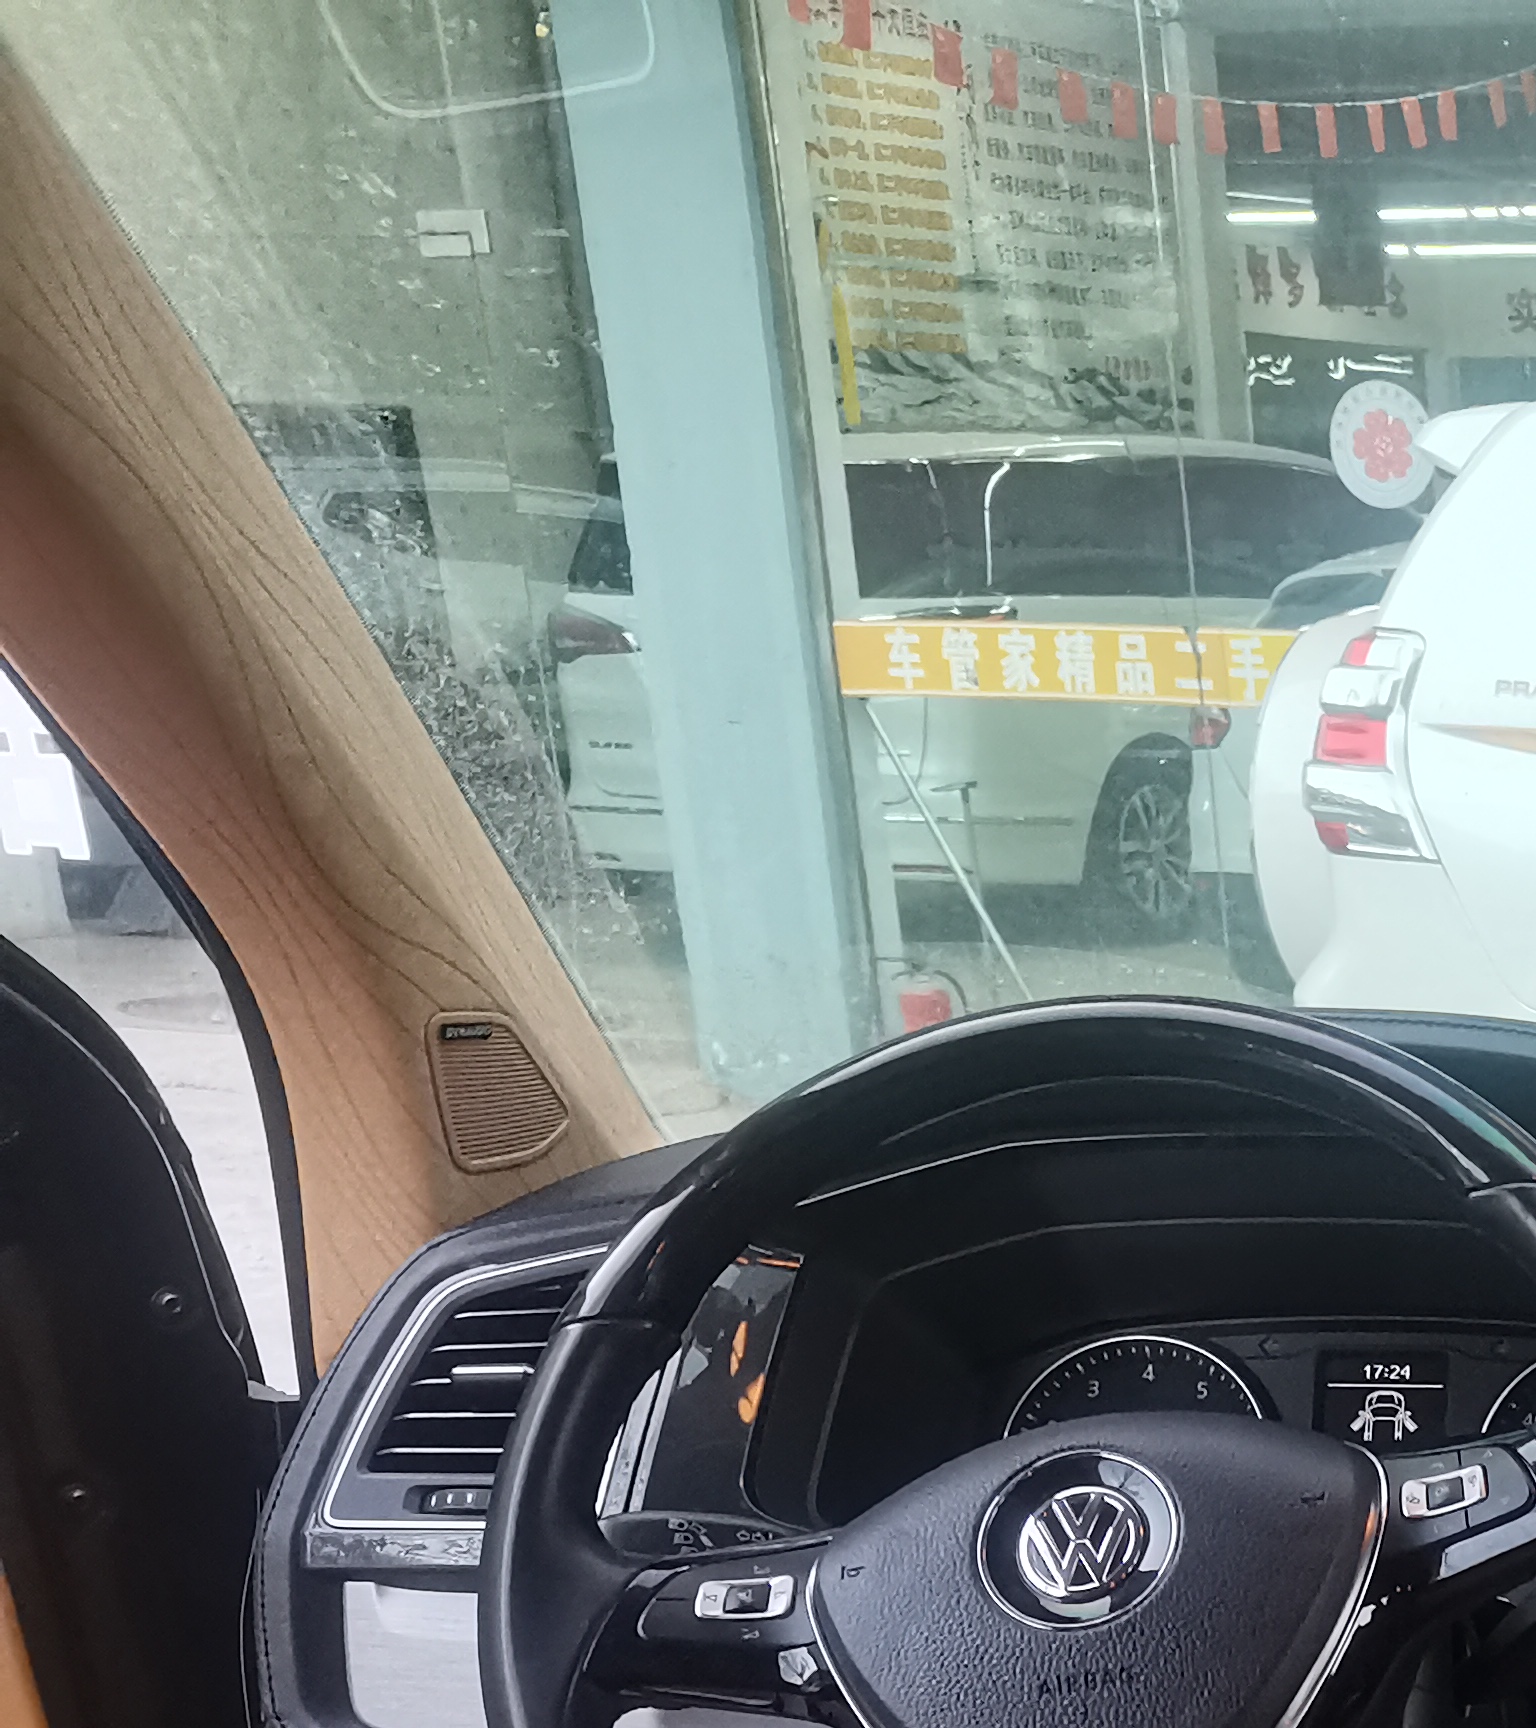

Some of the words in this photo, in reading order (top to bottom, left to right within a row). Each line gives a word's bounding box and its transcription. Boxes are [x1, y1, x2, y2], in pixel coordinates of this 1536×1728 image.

[1142, 1363, 1155, 1383] 4
[1363, 1364, 1411, 1380] 17:24
[1087, 1380, 1100, 1398] 3
[1196, 1381, 1209, 1400] 5
